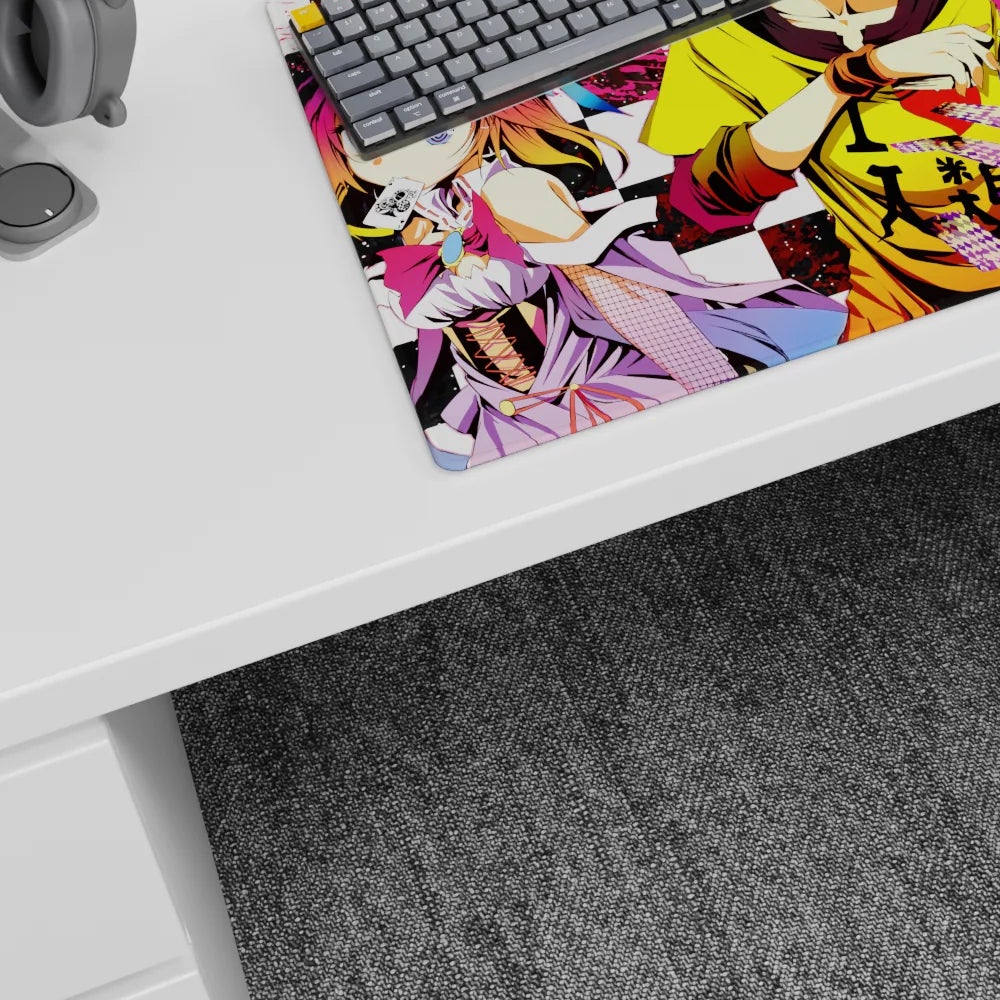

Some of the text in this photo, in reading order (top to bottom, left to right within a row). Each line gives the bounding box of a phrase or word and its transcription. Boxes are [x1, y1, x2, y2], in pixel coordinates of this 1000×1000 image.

[368, 89, 383, 98] shift
[438, 84, 467, 99] command
[403, 102, 423, 113] option
[362, 117, 383, 129] control
